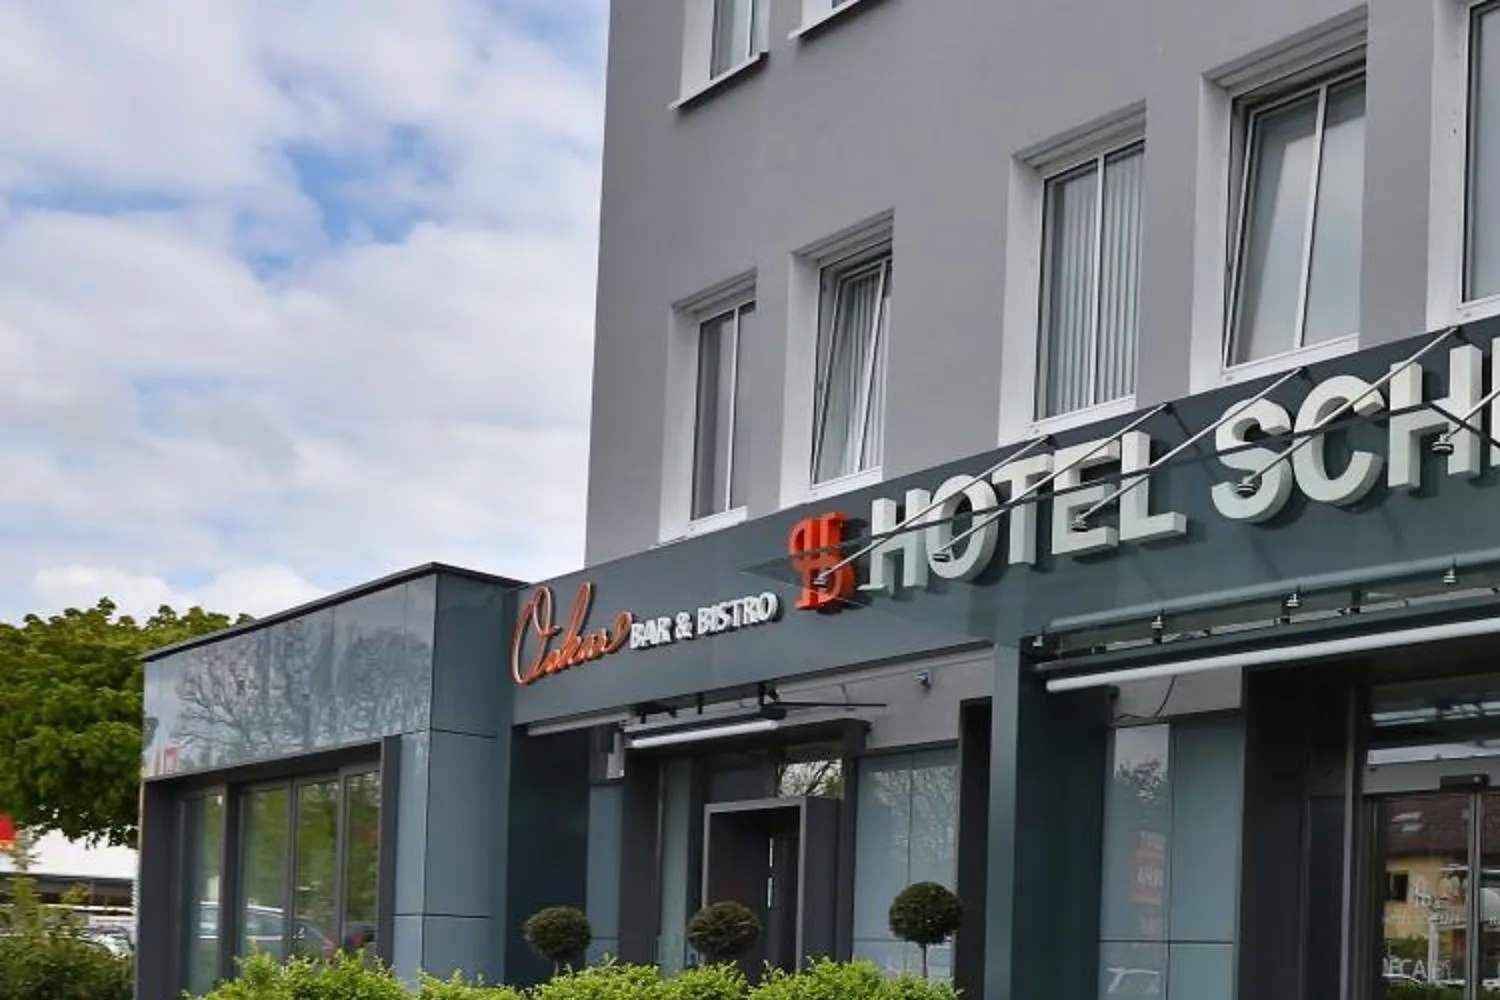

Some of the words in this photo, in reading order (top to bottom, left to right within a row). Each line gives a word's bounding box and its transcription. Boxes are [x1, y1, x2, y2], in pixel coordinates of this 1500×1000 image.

[866, 430, 1187, 592] HOTEL
[629, 616, 671, 649] BAR
[675, 611, 693, 640] &
[697, 591, 778, 635] BISTRO
